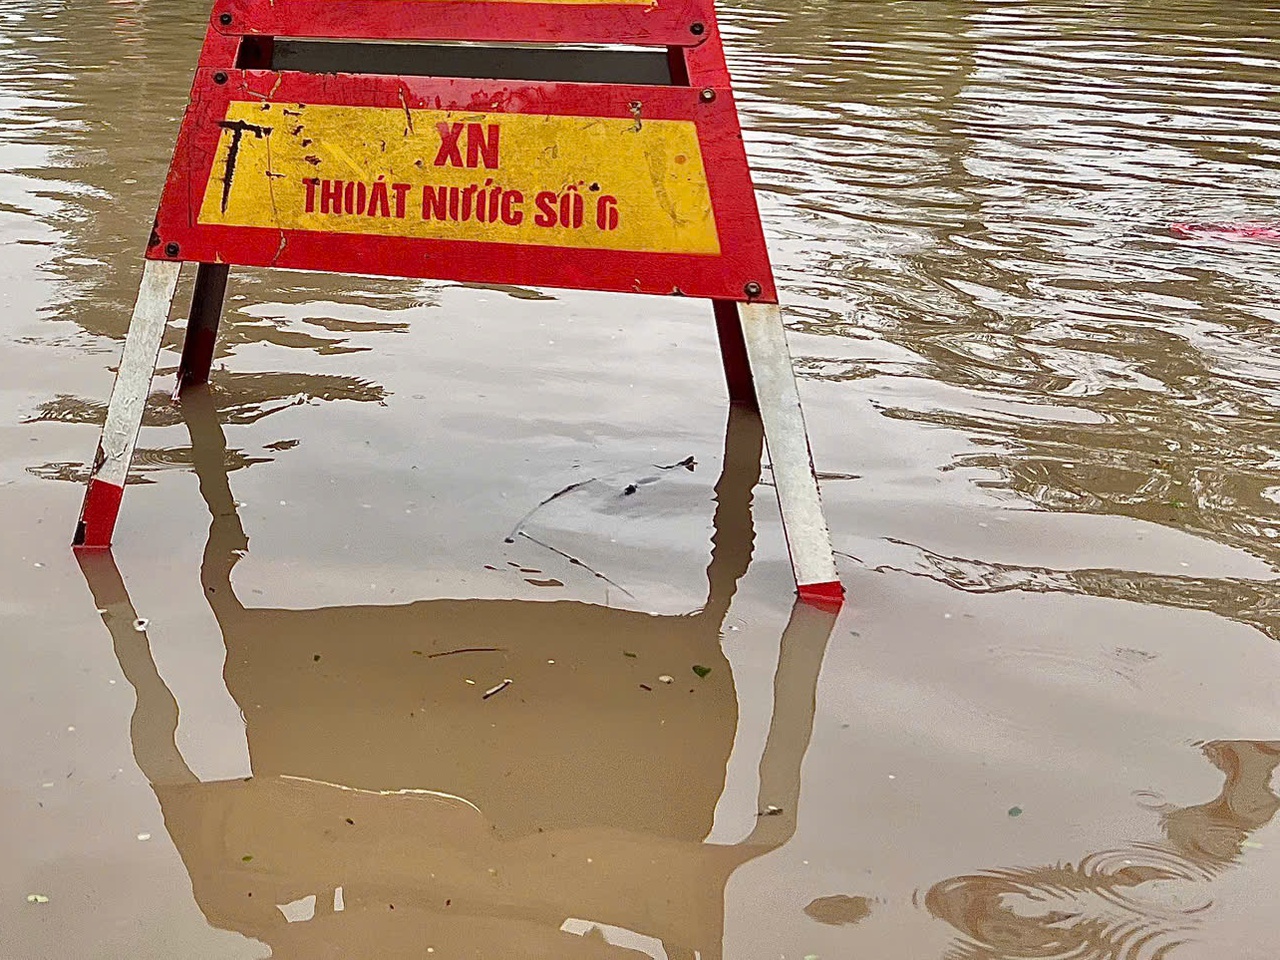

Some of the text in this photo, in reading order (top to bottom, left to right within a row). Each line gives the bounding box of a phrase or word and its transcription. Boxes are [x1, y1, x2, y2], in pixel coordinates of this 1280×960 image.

[433, 121, 500, 169] XN
[302, 174, 619, 231] THOÁT NƯỚC SỐ 6
